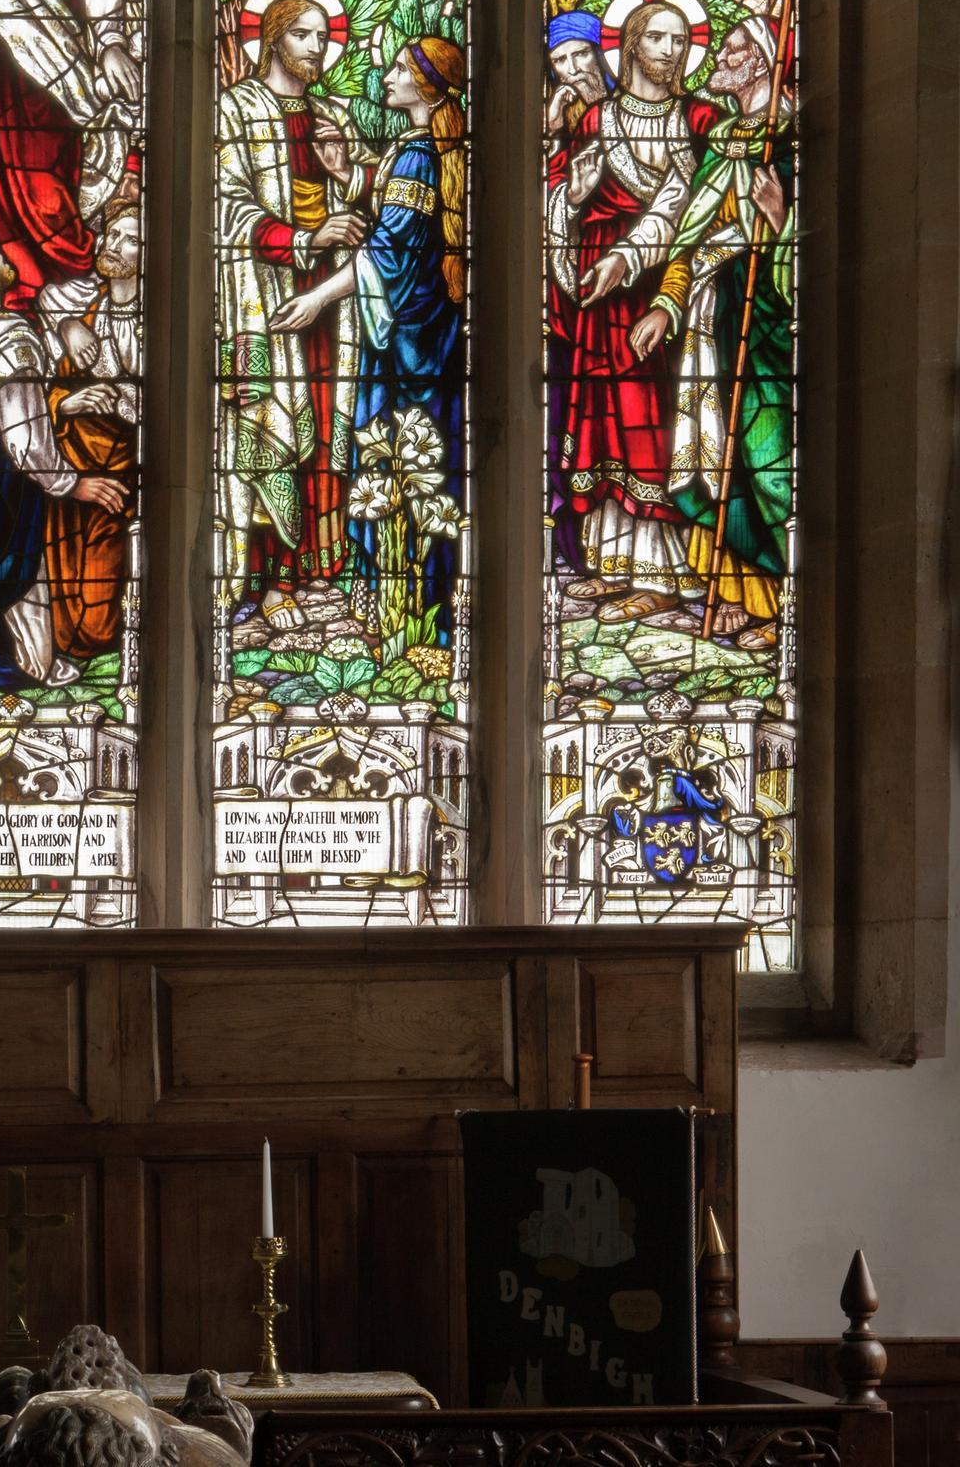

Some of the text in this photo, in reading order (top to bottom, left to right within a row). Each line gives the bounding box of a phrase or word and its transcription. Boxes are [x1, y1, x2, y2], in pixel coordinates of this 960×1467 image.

[9, 814, 38, 827] GLORY
[42, 814, 53, 827] OF
[57, 814, 78, 827] GOD
[81, 814, 103, 827] AND
[107, 814, 118, 827] IN
[225, 811, 382, 825] LOVING AND GRATEFUL MEMORY
[21, 833, 72, 847] HARRISON
[84, 834, 105, 847] AND
[225, 831, 381, 844] ELIZABETH FRANCES HIS WIFE
[28, 852, 74, 866] CHILDREN
[89, 853, 118, 867] ARISE
[224, 850, 246, 864] AND
[255, 850, 280, 864] CALL
[286, 850, 313, 864] THEM
[618, 874, 646, 882] VIGET
[699, 875, 727, 883] SIMILE
[498, 1269, 655, 1404] DENBIGH
